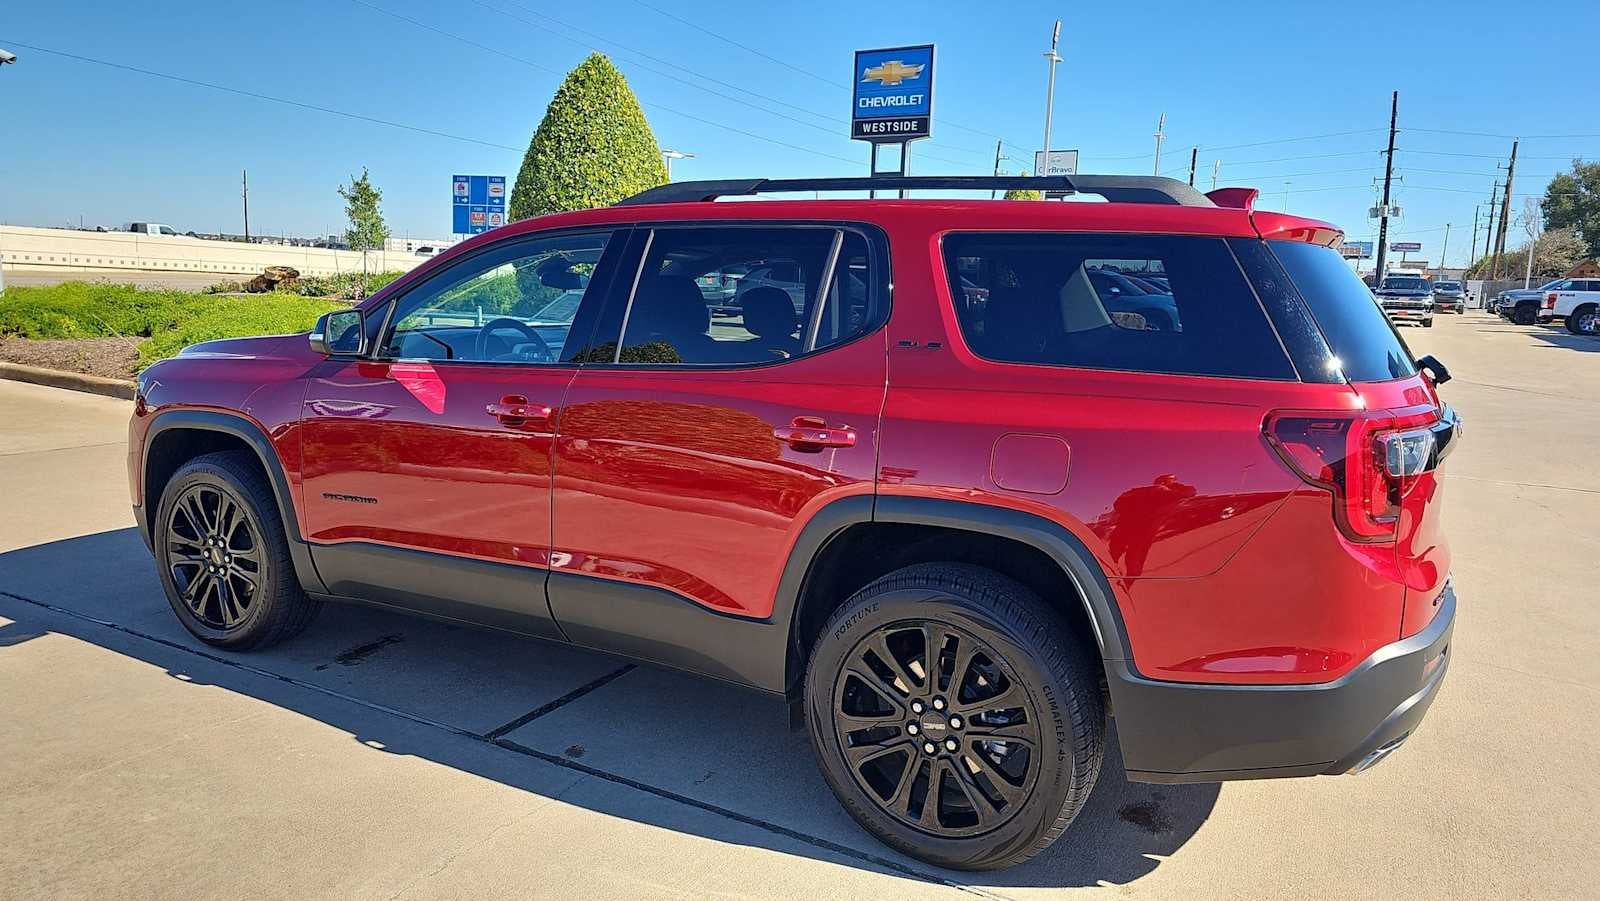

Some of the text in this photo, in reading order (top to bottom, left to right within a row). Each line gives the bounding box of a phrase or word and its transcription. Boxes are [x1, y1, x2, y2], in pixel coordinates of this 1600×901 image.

[859, 94, 924, 108] CHEVROLET
[862, 121, 919, 133] WESTSIDE
[1038, 166, 1073, 174] CrBravo
[834, 602, 880, 641] FORTUNE
[1042, 685, 1065, 744] CLIMAFLEX
